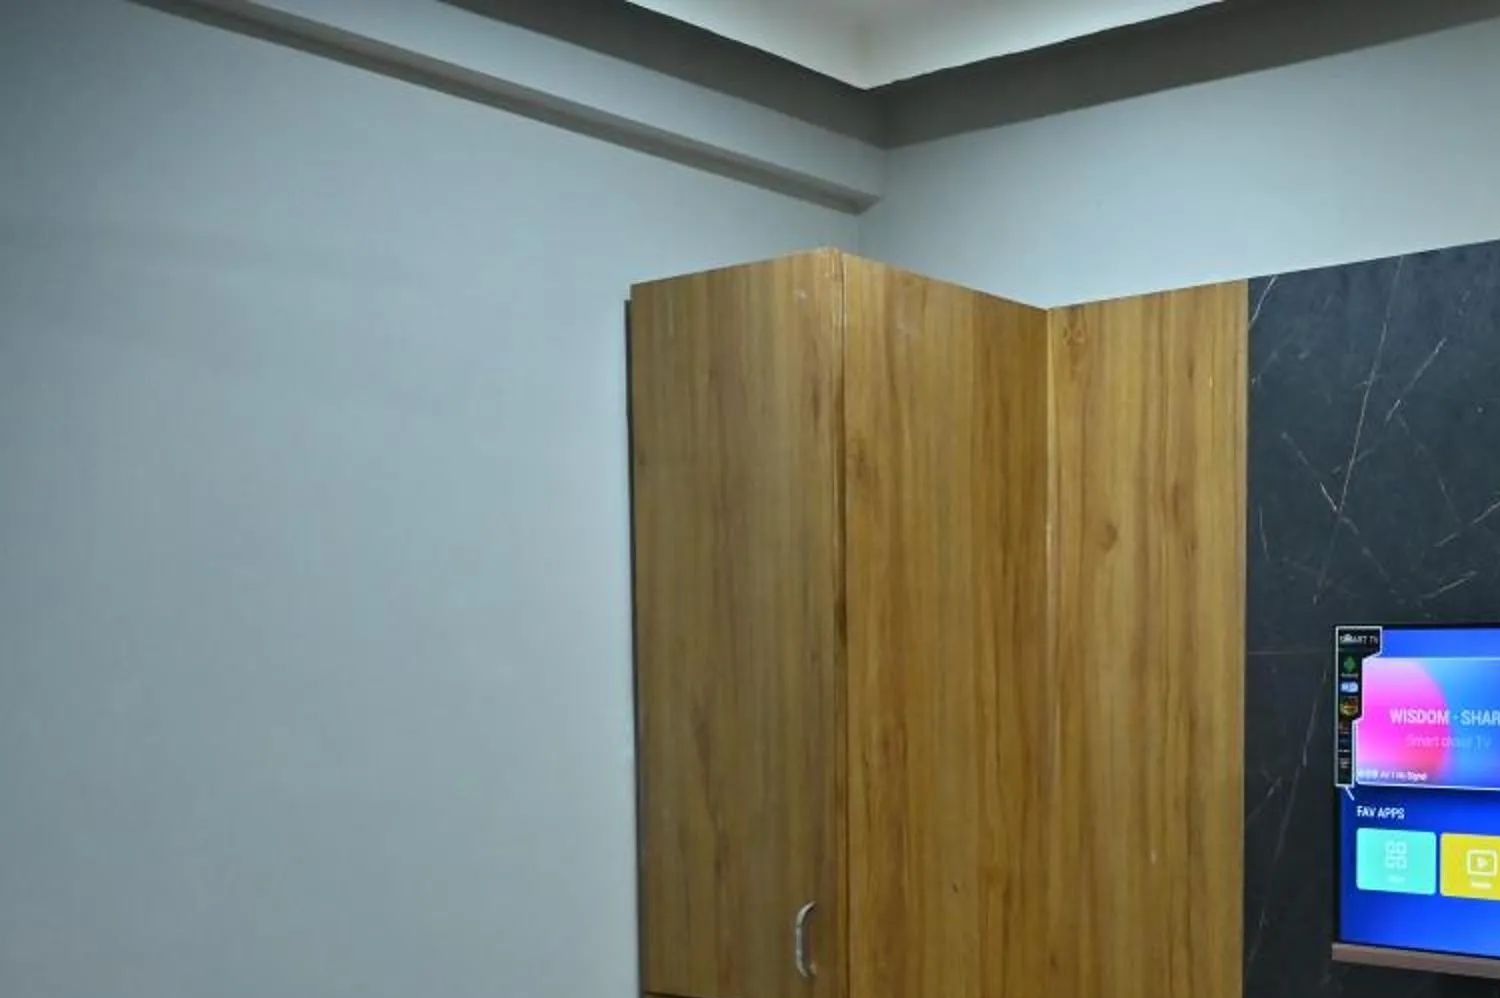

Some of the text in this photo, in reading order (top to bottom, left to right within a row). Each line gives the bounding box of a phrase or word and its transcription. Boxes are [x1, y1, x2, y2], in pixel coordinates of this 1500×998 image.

[1389, 708, 1449, 726] WISDOM
[1405, 734, 1440, 748] Smart
[1356, 805, 1405, 820] FAV APPS
